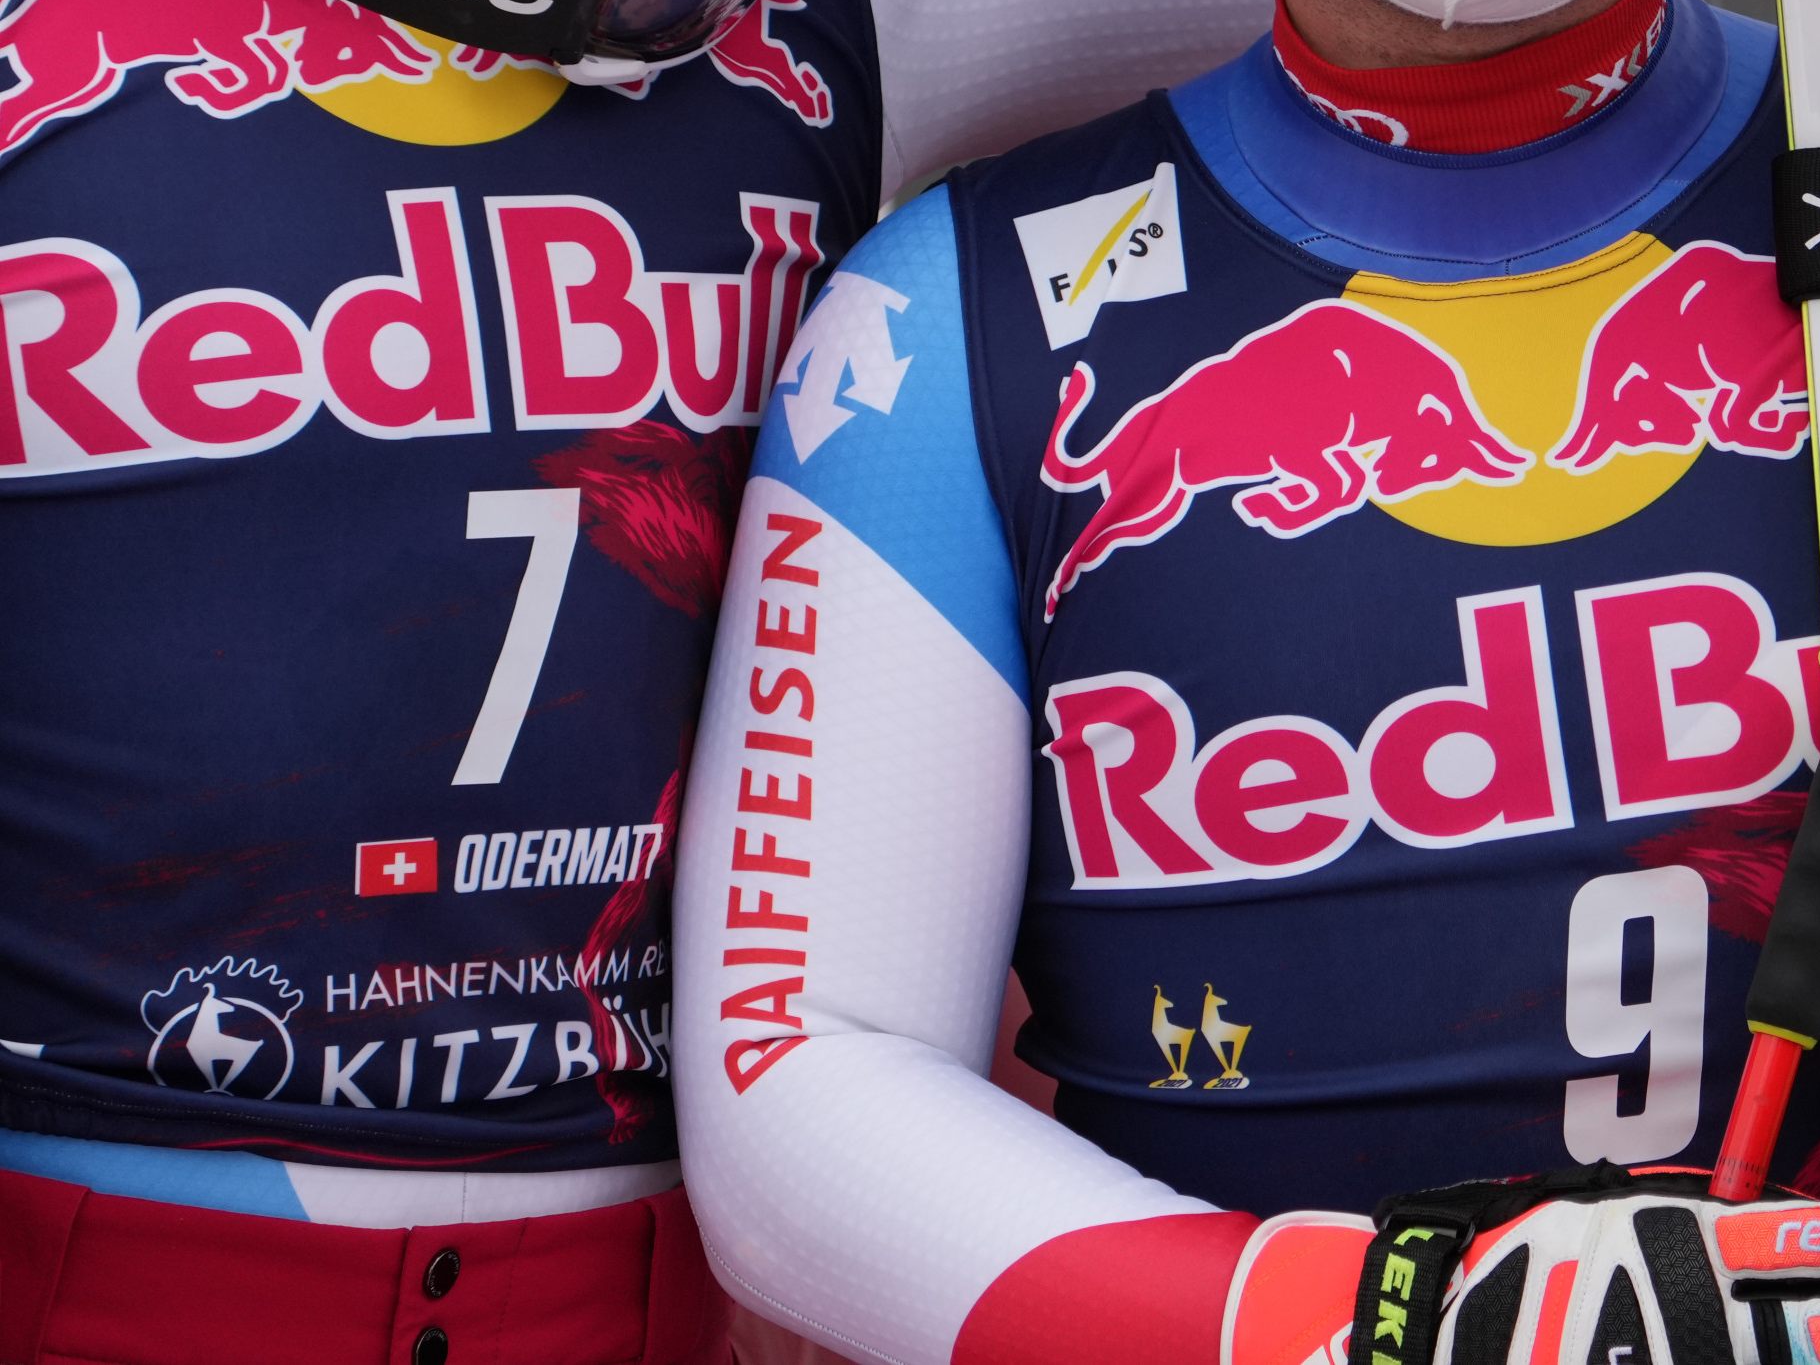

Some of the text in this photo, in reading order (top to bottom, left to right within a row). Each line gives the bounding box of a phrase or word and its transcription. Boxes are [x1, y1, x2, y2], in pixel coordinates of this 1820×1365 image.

[0, 189, 823, 473] Red Bull
[451, 487, 580, 785] 7
[1045, 589, 1568, 885] Red
[454, 823, 664, 894] ODERMATT
[720, 514, 823, 1096] RAIFFEISEN
[321, 995, 670, 1110] KITZBÜH
[326, 947, 630, 1013] HAHNENKAMM
[1564, 864, 1708, 1165] 9
